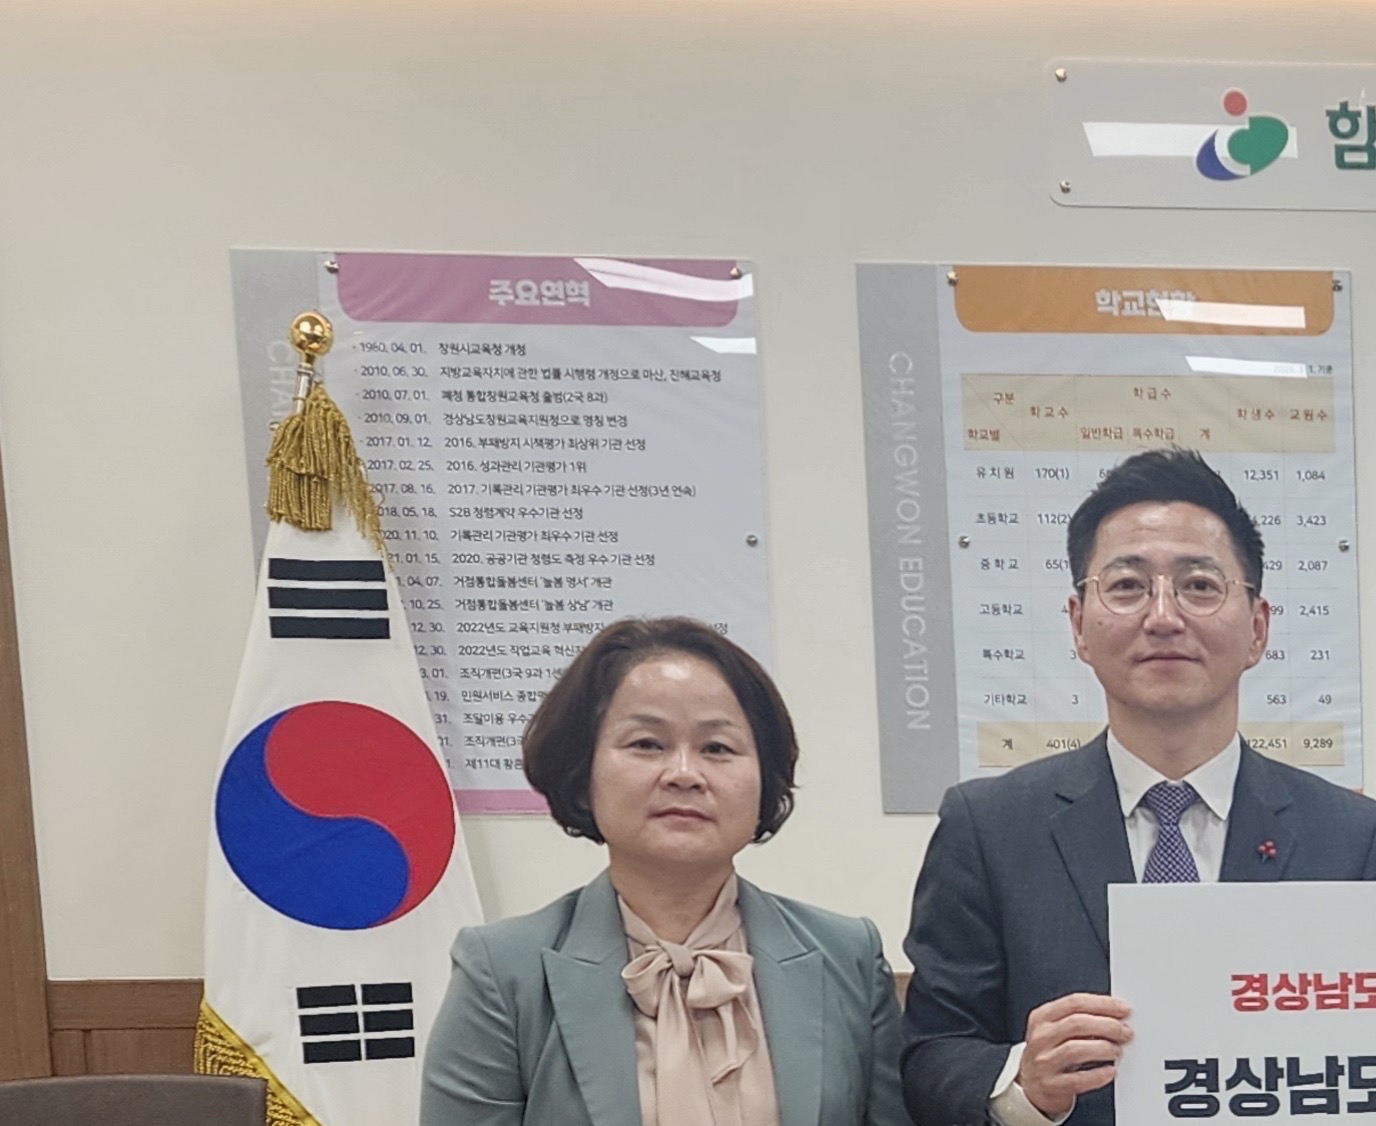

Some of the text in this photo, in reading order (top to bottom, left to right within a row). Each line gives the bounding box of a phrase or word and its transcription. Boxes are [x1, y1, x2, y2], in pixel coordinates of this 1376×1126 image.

[488, 279, 590, 307] 주요연혁
[439, 343, 502, 355] 창원시교육청
[361, 366, 390, 377] 2010.
[440, 367, 514, 378] 지방교육자치에
[517, 368, 538, 379] 관한
[541, 368, 561, 379] 법률
[670, 369, 722, 381] 진해교육청
[363, 390, 392, 401] 2010.
[466, 391, 539, 402] 통합창원교육청
[994, 392, 1014, 404] 구분
[364, 413, 394, 425] 2010.
[444, 415, 582, 426] 경상남도창원교육지원청으로
[606, 416, 628, 427] 변경
[968, 428, 1000, 442] 학교별
[1081, 427, 1123, 440] 일반학급
[366, 437, 396, 448] 2017.
[445, 438, 476, 449] 2016.
[602, 440, 623, 450] 기관
[625, 440, 646, 451] 선정
[368, 460, 397, 471] 2017.
[446, 461, 477, 472] 2016.
[481, 461, 522, 472] 성과관리
[524, 461, 567, 472] 기관평가
[570, 462, 587, 472] 1위
[1035, 468, 1070, 480] 170(1)
[1244, 470, 1280, 482] 12,351
[1297, 471, 1326, 482] 1,084
[448, 484, 625, 496] 2017. 기록관리 기관평가 최우수 기관
[518, 508, 560, 518] 우수기관
[562, 508, 584, 519] 선정
[976, 513, 1020, 524] 초등학교
[1297, 516, 1326, 527] 3,423
[451, 531, 618, 542] 기록관리 기관평가 최우수 기관 선정
[889, 352, 931, 730] CHANGWON EDUCATION
[452, 553, 482, 564] 2020.
[486, 553, 528, 564] 공공기관
[588, 554, 608, 564] 우수
[611, 554, 632, 564] 기관
[634, 554, 656, 564] 선정
[1298, 561, 1328, 572] 2,087
[980, 604, 1023, 616] 고등학교
[1300, 606, 1330, 616] 2,415
[457, 622, 560, 633] 2022년도 교육지원청
[459, 645, 551, 656] 2022년도 직업교육
[1070, 650, 1076, 660] 3
[1265, 650, 1286, 660] 683
[1310, 650, 1330, 660] 231
[462, 691, 514, 702] 민원서비스
[1072, 694, 1078, 704] 3
[1267, 695, 1286, 704] 563
[1318, 695, 1332, 704] 49
[1002, 738, 1013, 750] 계
[1046, 739, 1082, 750] 401(4)
[1304, 739, 1333, 750] 9,289
